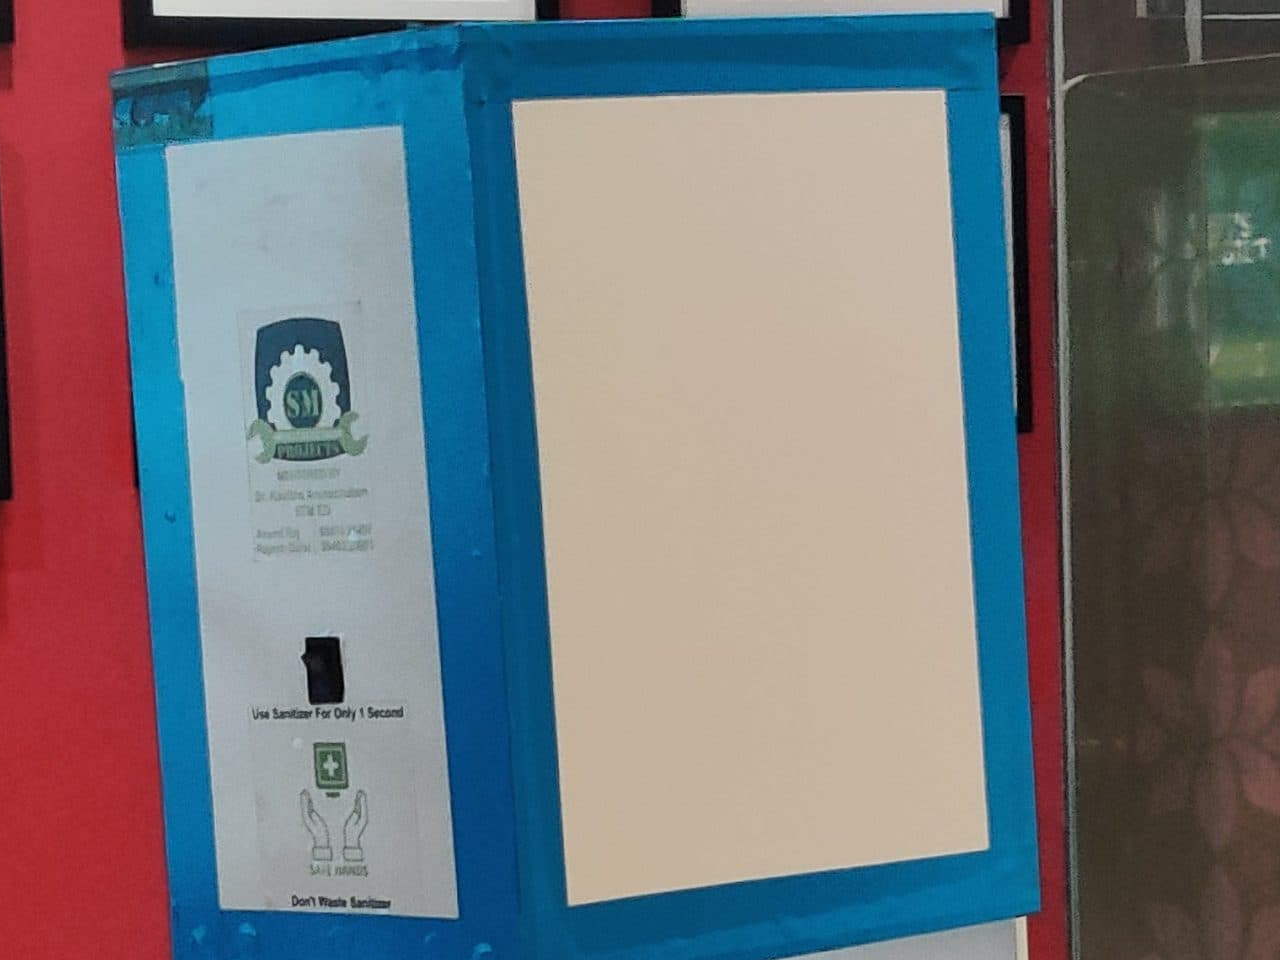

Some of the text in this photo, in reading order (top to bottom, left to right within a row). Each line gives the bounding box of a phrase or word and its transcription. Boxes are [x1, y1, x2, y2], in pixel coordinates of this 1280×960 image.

[285, 389, 320, 418] SM
[251, 707, 270, 720] Use
[272, 706, 313, 720] Sanitizer
[315, 707, 332, 719] For
[334, 706, 357, 722] Only
[367, 705, 404, 719] Second
[291, 895, 392, 909] Don't Waste Sanitizer
